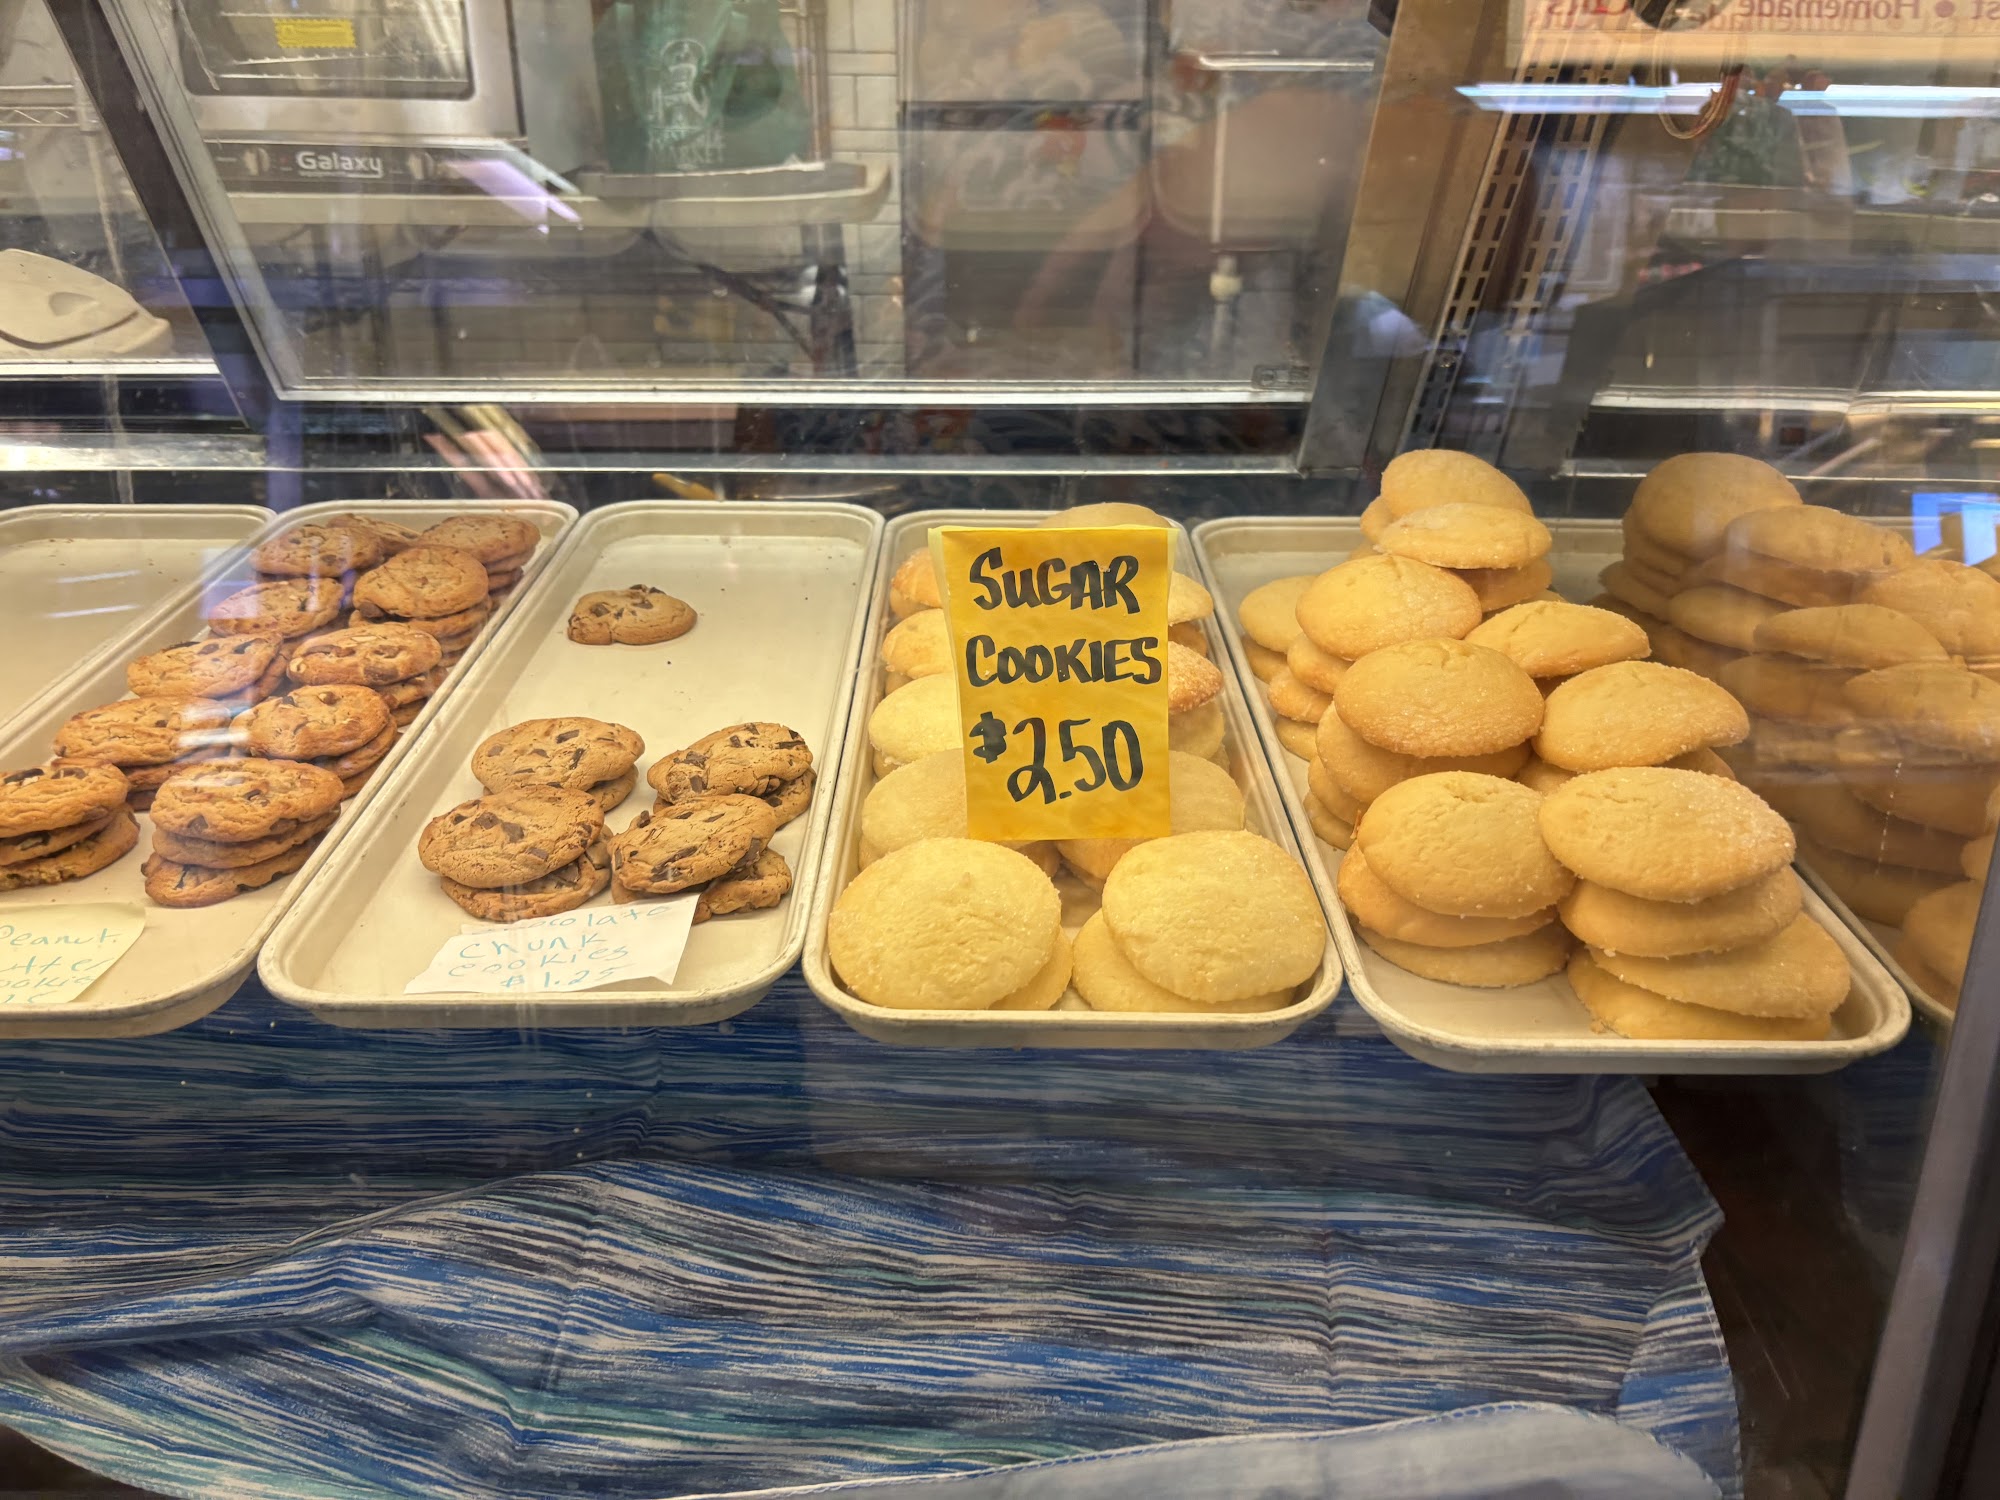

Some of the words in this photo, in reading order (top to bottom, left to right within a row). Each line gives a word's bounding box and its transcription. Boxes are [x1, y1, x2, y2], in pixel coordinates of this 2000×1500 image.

[297, 151, 382, 176] Galaxy
[969, 547, 1140, 614] SUGAR
[966, 635, 1162, 687] COOKIES
[969, 712, 1143, 805] $2.50
